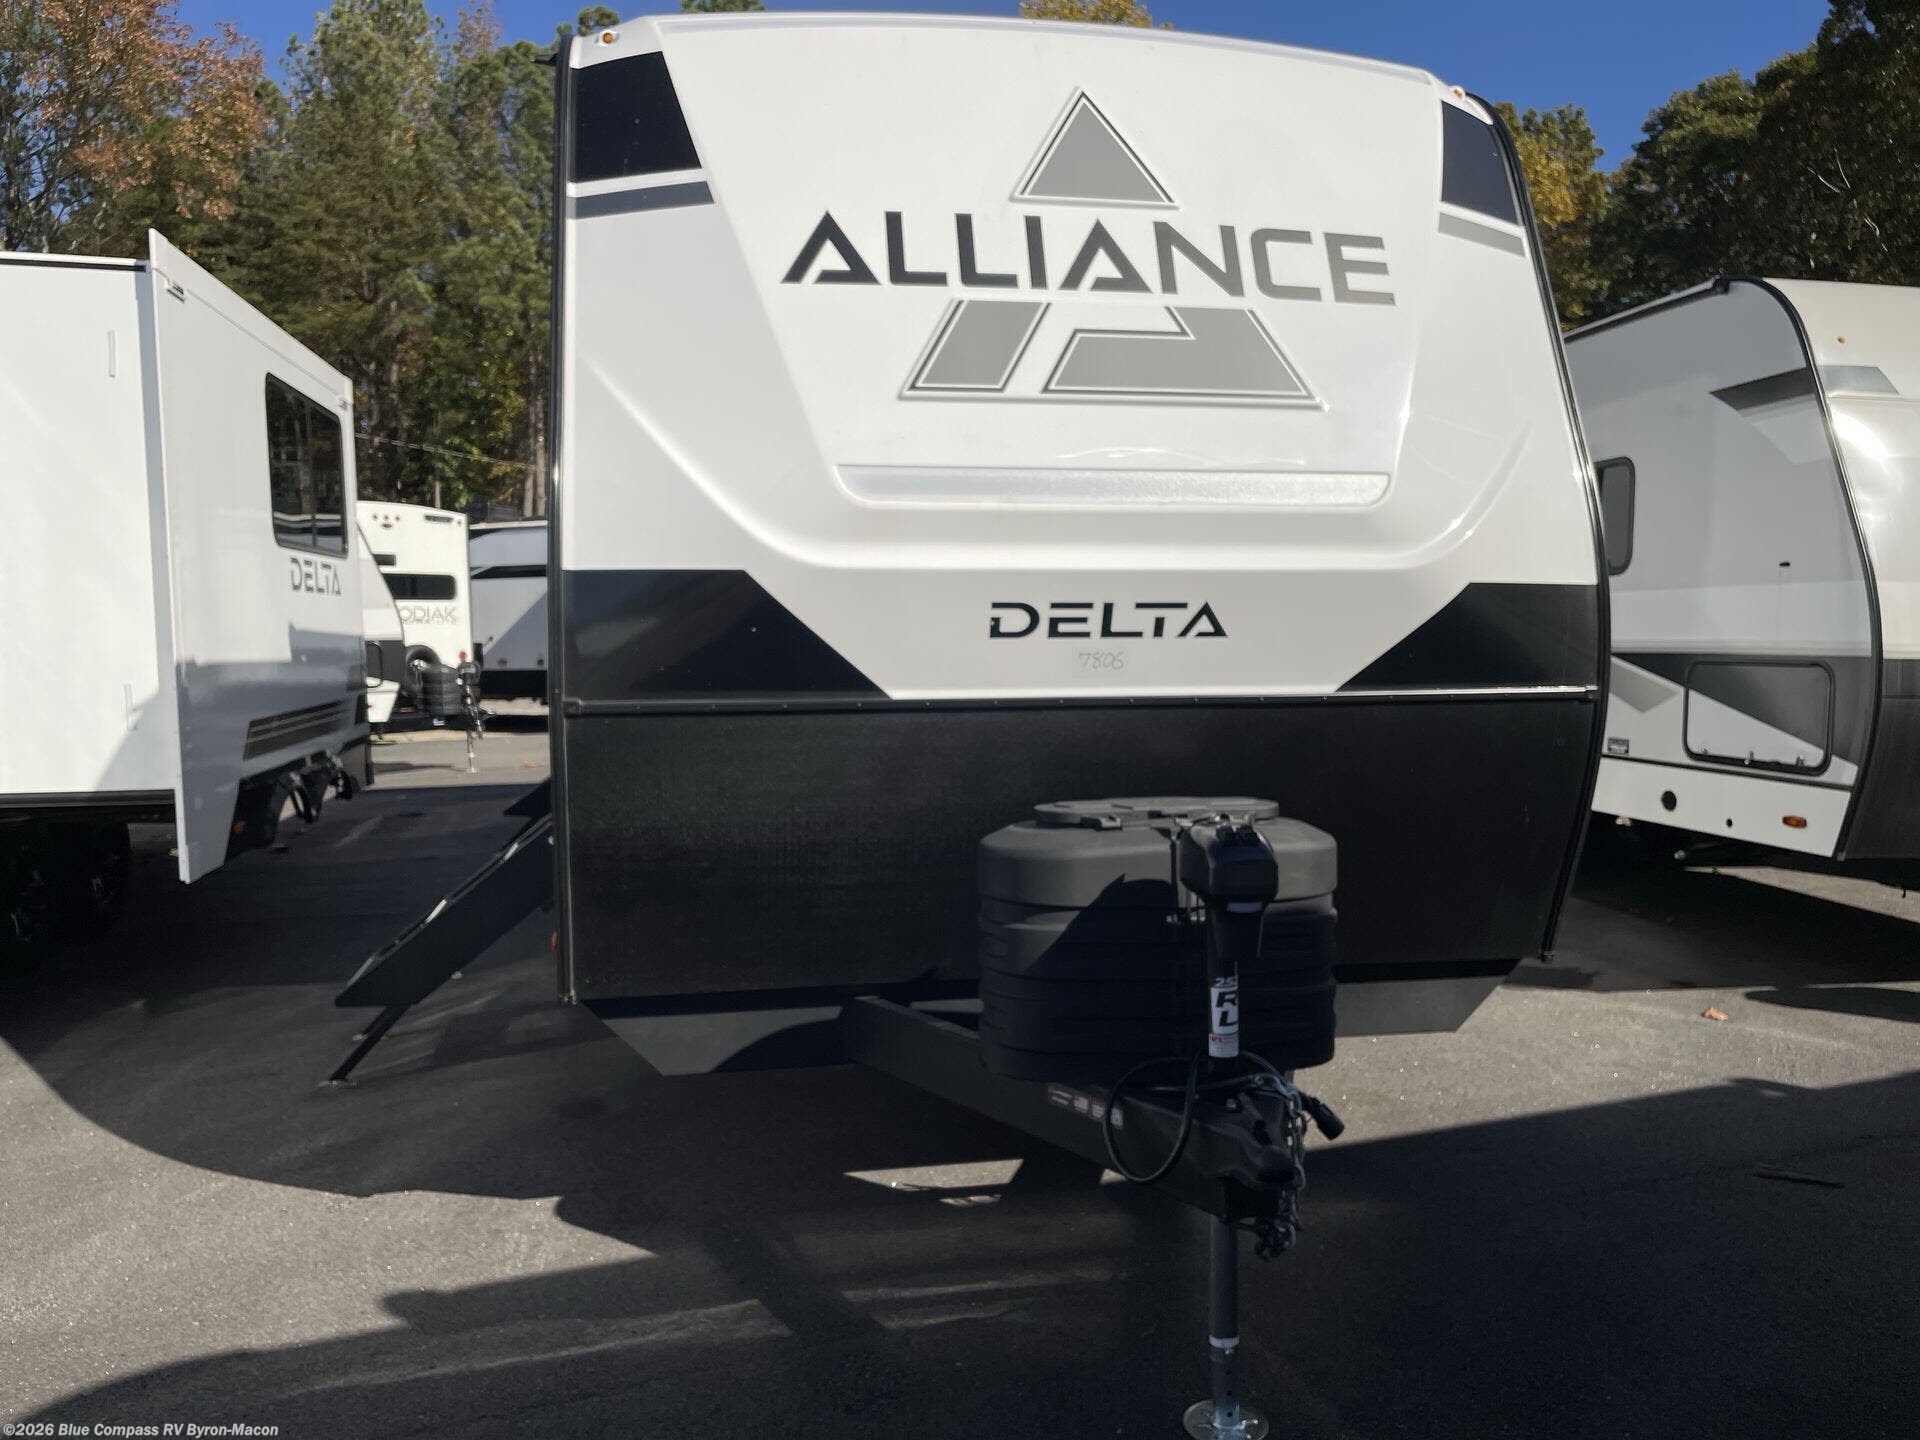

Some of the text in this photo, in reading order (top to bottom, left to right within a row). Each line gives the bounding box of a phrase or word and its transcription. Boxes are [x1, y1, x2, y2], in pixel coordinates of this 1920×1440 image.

[780, 210, 1396, 305] ALLIANCE
[290, 557, 342, 596] DELTA
[399, 605, 456, 621] ODIAK
[989, 601, 1228, 638] DELTA
